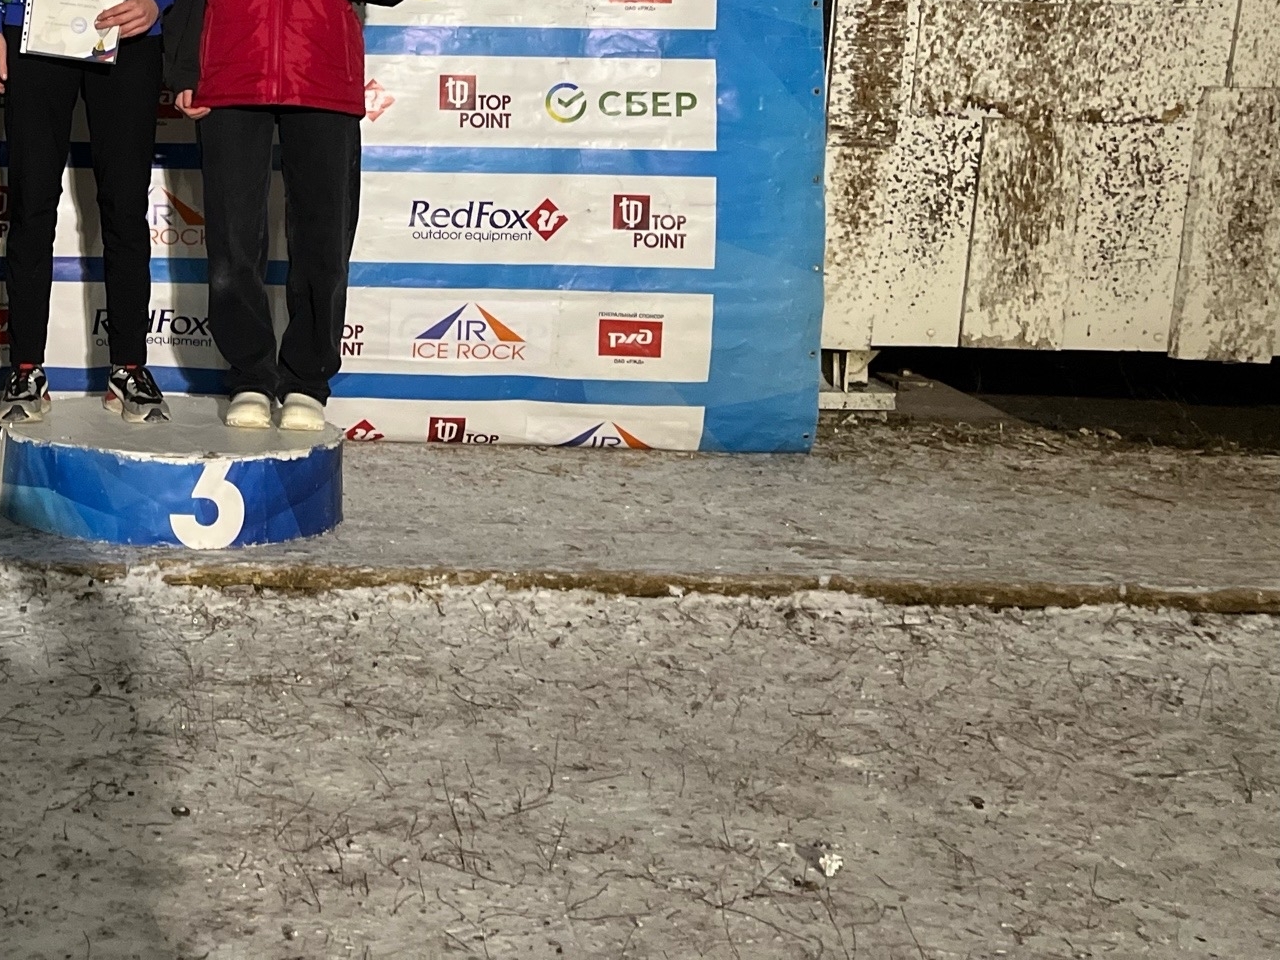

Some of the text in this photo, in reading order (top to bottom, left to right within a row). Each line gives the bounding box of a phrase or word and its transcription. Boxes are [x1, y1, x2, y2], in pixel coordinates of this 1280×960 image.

[478, 95, 512, 110] TOP
[598, 91, 697, 117] СБЕР
[460, 113, 512, 128] POINT
[408, 200, 530, 229] RedFox
[652, 214, 687, 230] TOP
[412, 229, 532, 242] outdoor equipment
[633, 233, 687, 249] POINT
[341, 325, 364, 339] OP
[146, 335, 213, 347] equipment
[412, 343, 526, 361] ICE ROCK
[465, 433, 500, 444] TOP
[169, 459, 245, 551] 3
